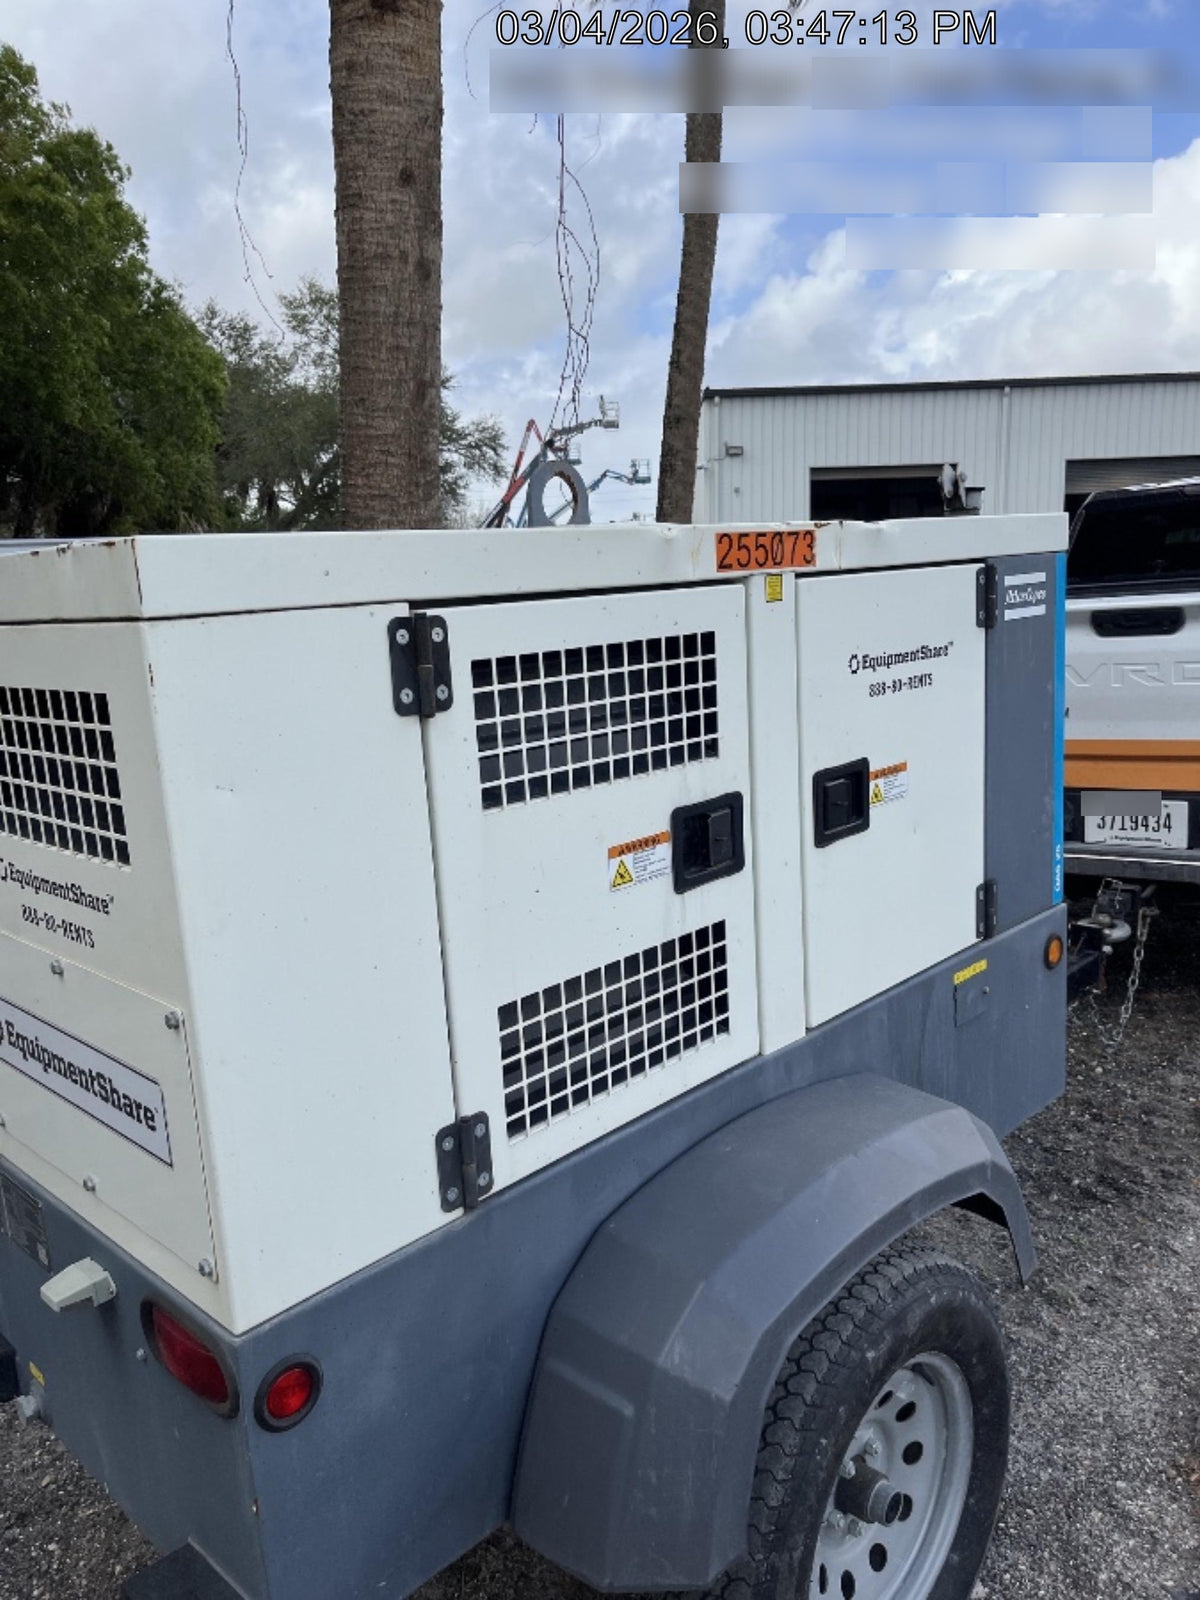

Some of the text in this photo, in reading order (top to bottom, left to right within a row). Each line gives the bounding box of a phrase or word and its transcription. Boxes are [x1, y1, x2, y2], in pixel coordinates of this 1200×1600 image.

[718, 530, 815, 569] 255073
[8, 861, 111, 915] EquipmentShare
[5, 1019, 157, 1132] EquipmentShare
